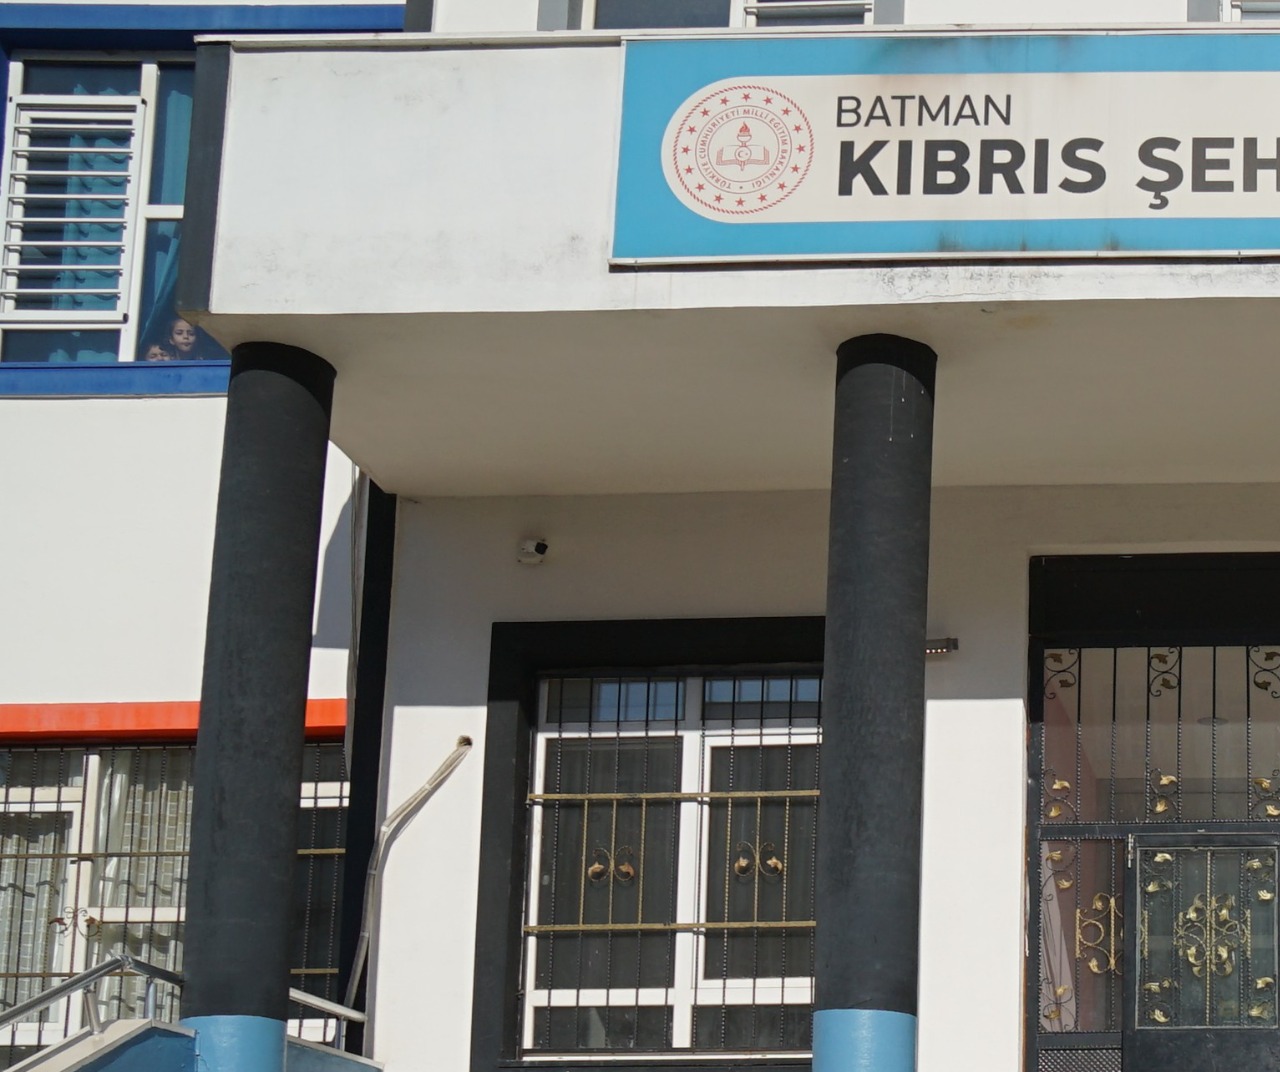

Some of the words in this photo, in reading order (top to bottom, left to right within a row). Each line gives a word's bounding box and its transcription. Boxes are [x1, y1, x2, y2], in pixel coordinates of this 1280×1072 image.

[699, 108, 739, 159] CUMHURİYETİ
[836, 94, 1012, 128] BATMAN
[837, 137, 1107, 197] KIBRIS
